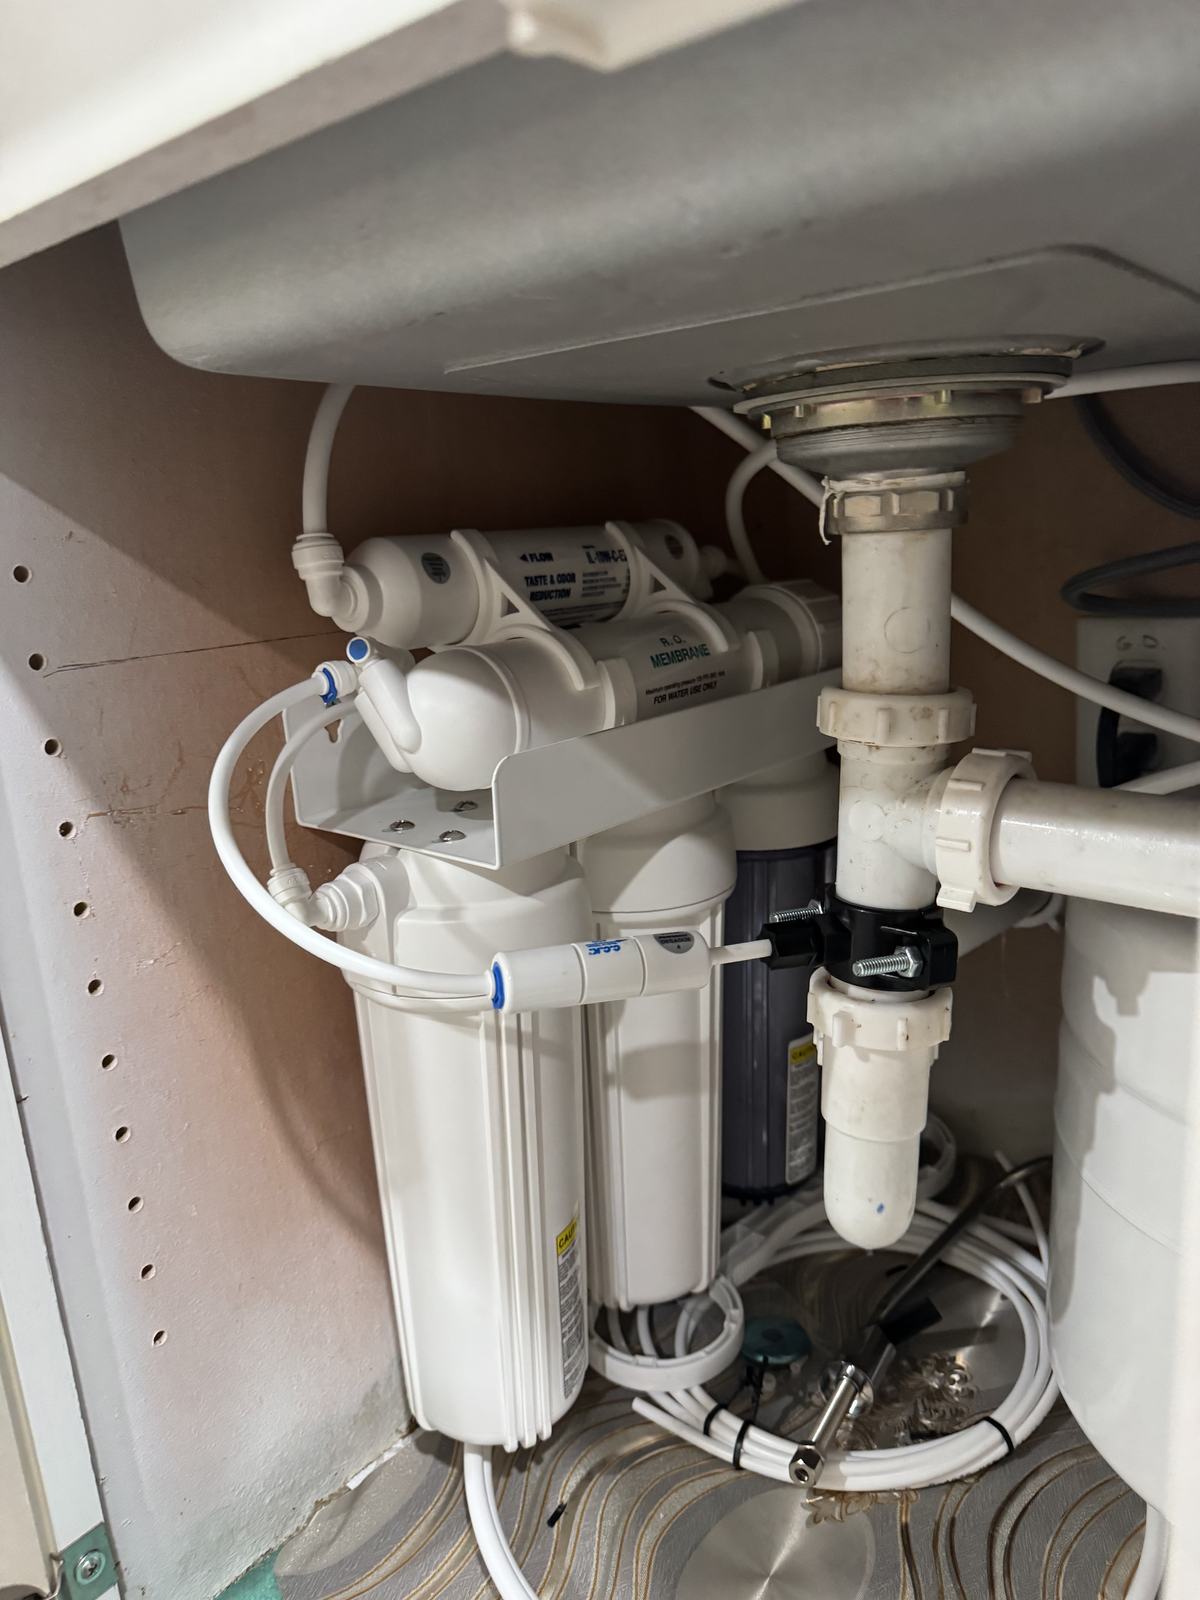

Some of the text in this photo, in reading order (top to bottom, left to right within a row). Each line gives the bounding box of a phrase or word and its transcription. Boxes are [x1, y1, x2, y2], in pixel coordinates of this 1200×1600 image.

[528, 552, 554, 562] FLOW
[524, 574, 548, 587] TASTE
[550, 574, 556, 585] &
[556, 572, 576, 584] ODOR
[529, 588, 571, 601] REDUCTION
[650, 643, 710, 669] MEMBRANE
[653, 680, 717, 704] FOR WATER USE ONLY
